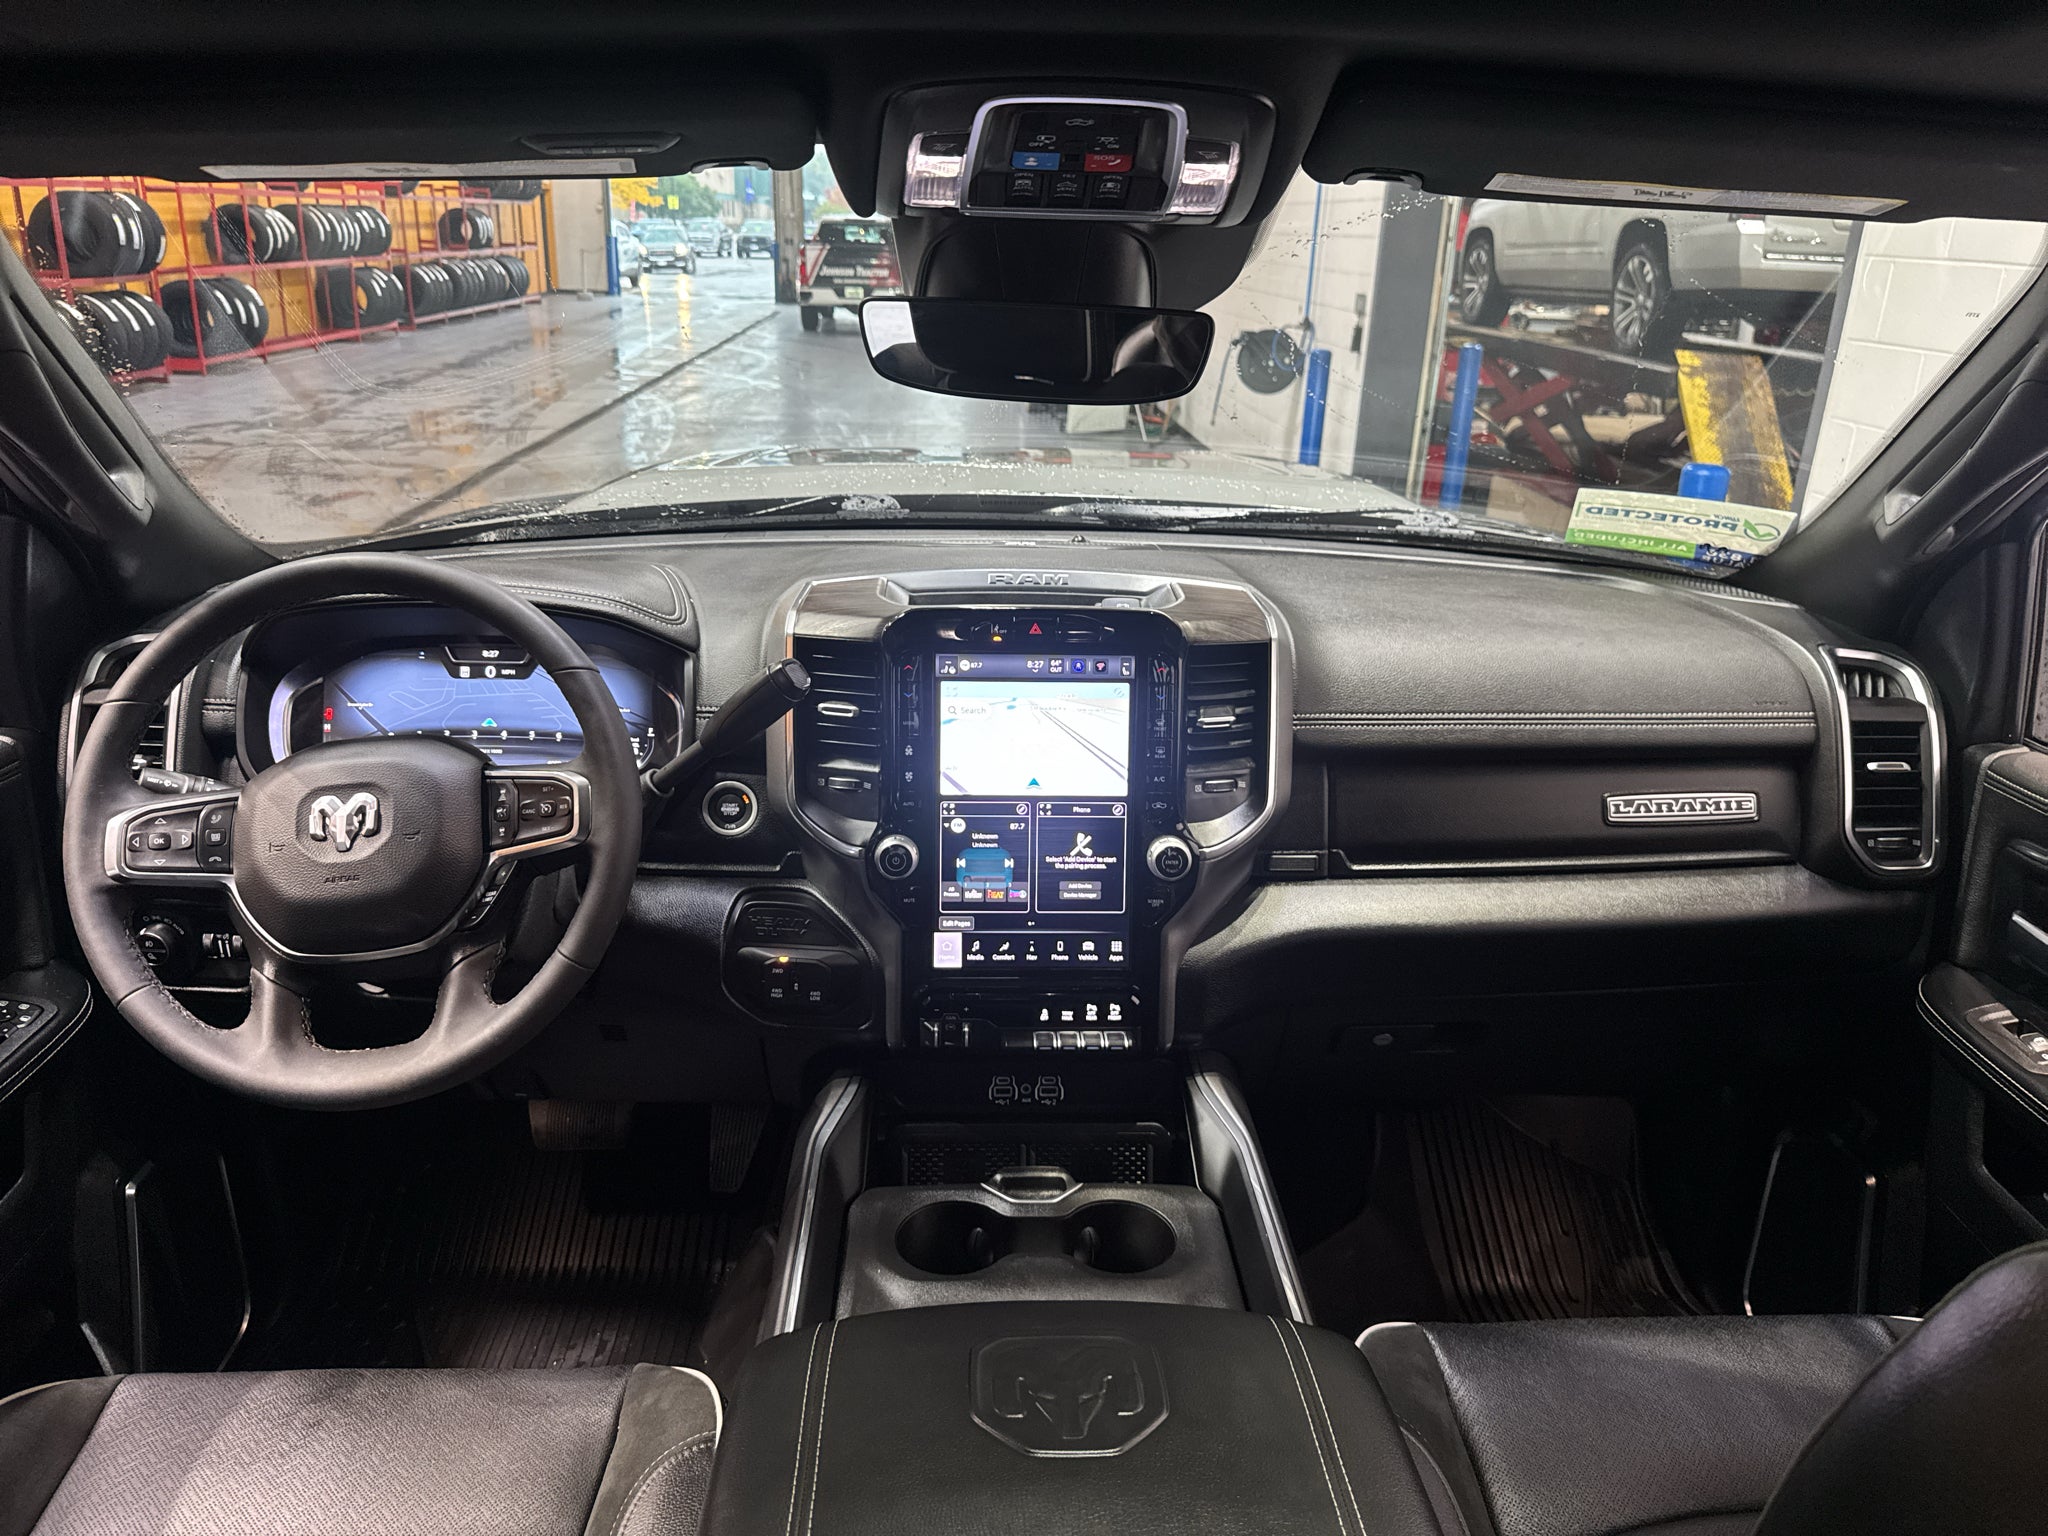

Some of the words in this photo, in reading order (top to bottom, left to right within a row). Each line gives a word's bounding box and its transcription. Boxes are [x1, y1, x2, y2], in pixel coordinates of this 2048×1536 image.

[987, 572, 1070, 586] RAM
[1026, 660, 1044, 668] 8:27
[485, 665, 496, 678] 0
[960, 706, 987, 714] Search
[1610, 798, 1754, 816] LARAMIE
[954, 920, 971, 928] Pages
[1109, 954, 1124, 962] Apps
